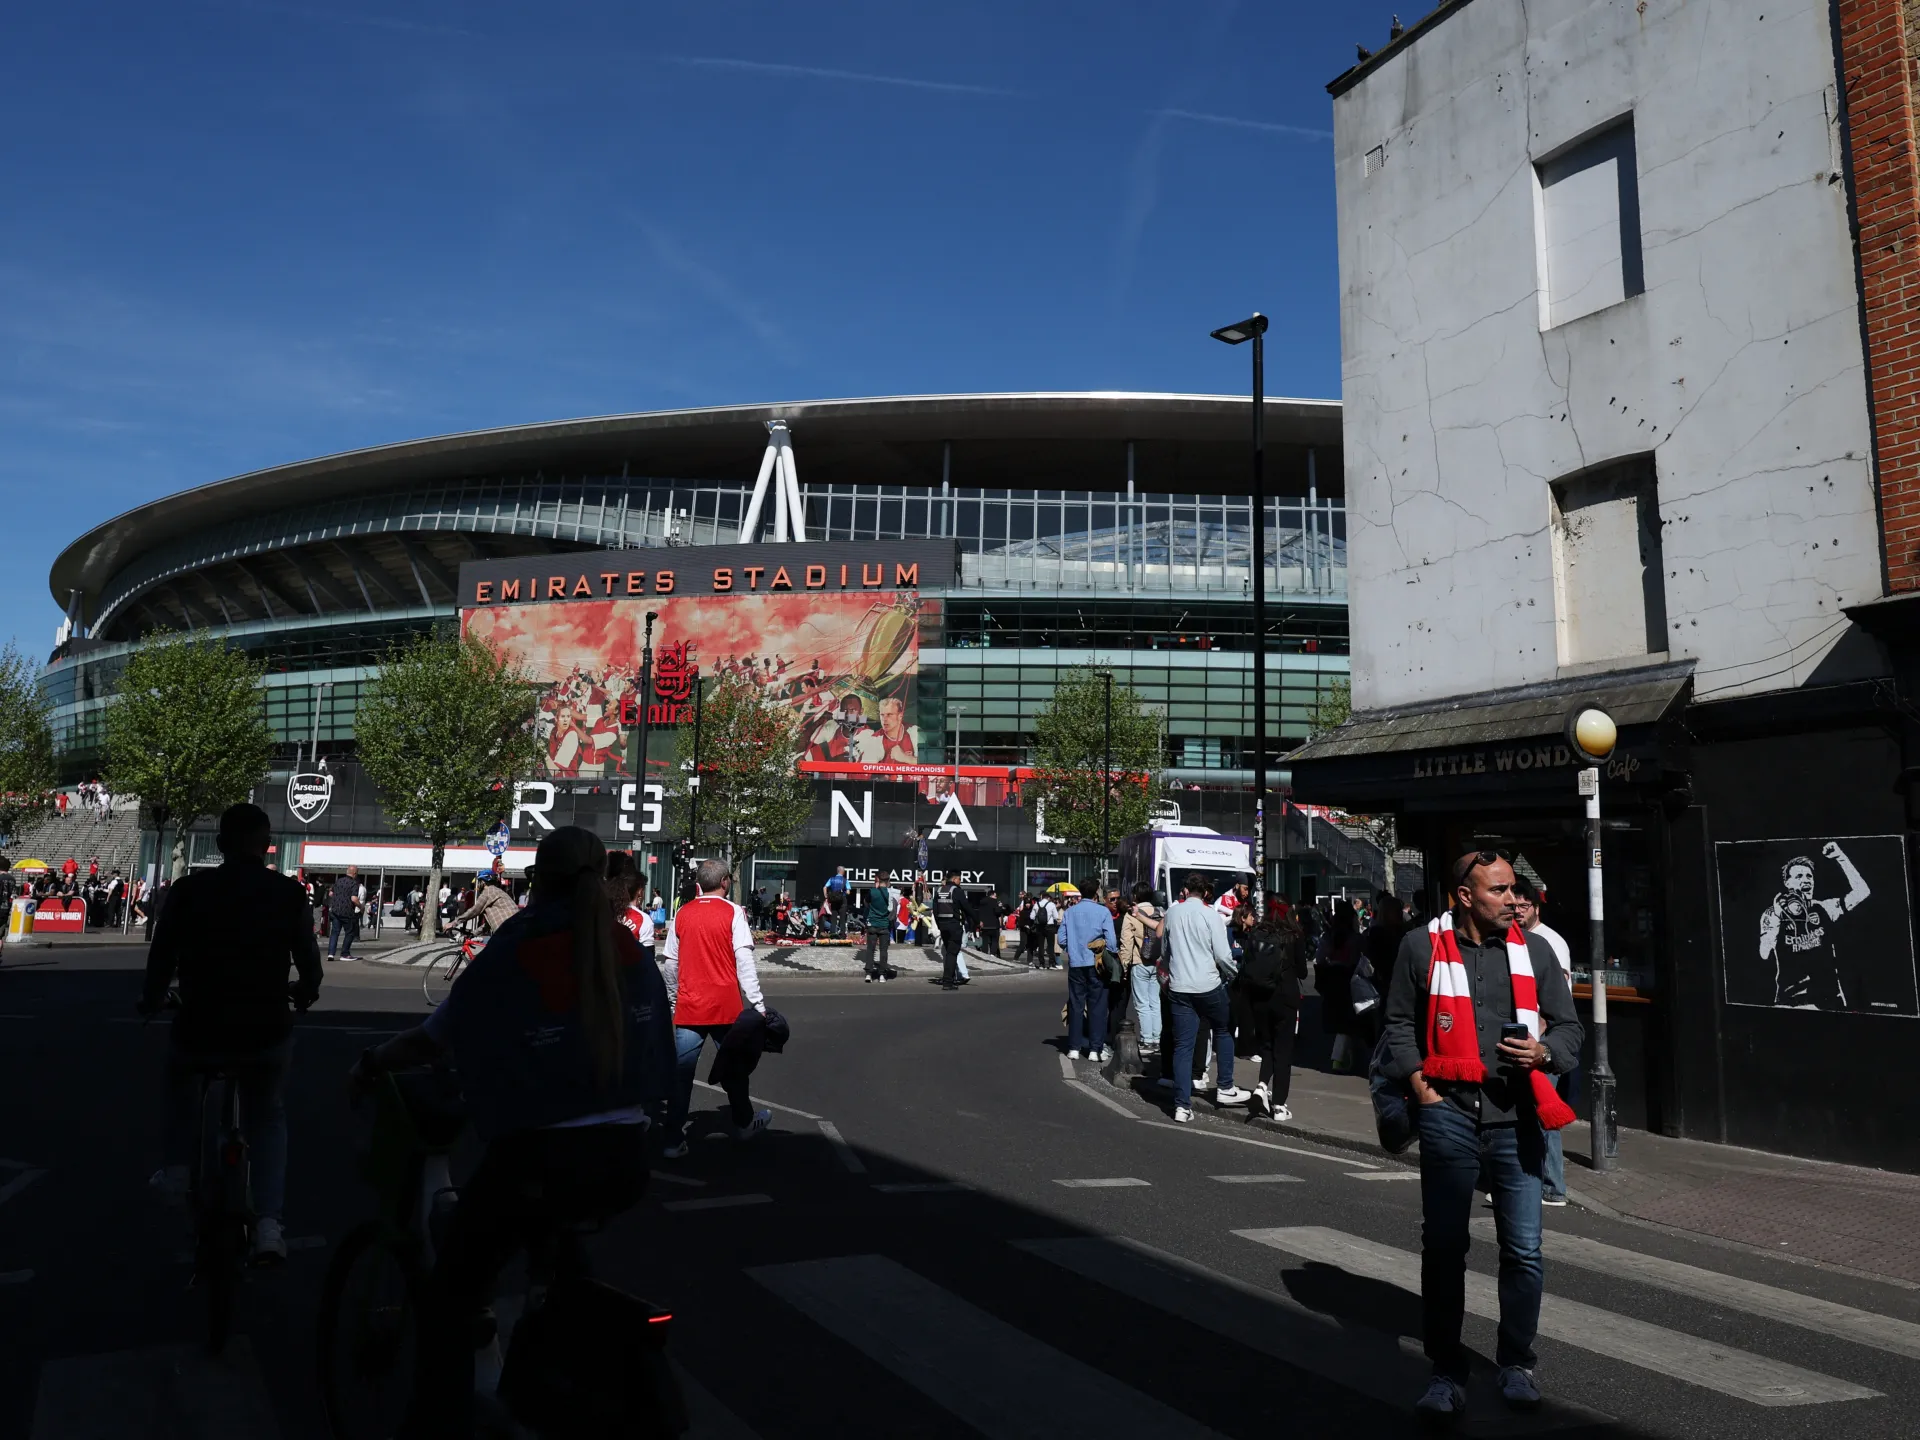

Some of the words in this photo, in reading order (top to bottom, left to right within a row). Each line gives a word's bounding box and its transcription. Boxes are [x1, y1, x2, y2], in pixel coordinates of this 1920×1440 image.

[476, 570, 675, 602] EMIRATES
[713, 562, 918, 590] STADIUM
[620, 698, 694, 724] Emira
[863, 764, 894, 772] OFFICIAL
[896, 766, 946, 774] MERCHANDISE
[1413, 752, 1486, 778] LITTLE
[1495, 745, 1579, 772] WOND
[1607, 753, 1641, 782] Cafe
[294, 783, 325, 792] Arsenal
[1197, 849, 1232, 857] ocado
[844, 868, 880, 881] THE
[889, 869, 984, 883] ARMORY
[61, 911, 82, 920] WOMEN
